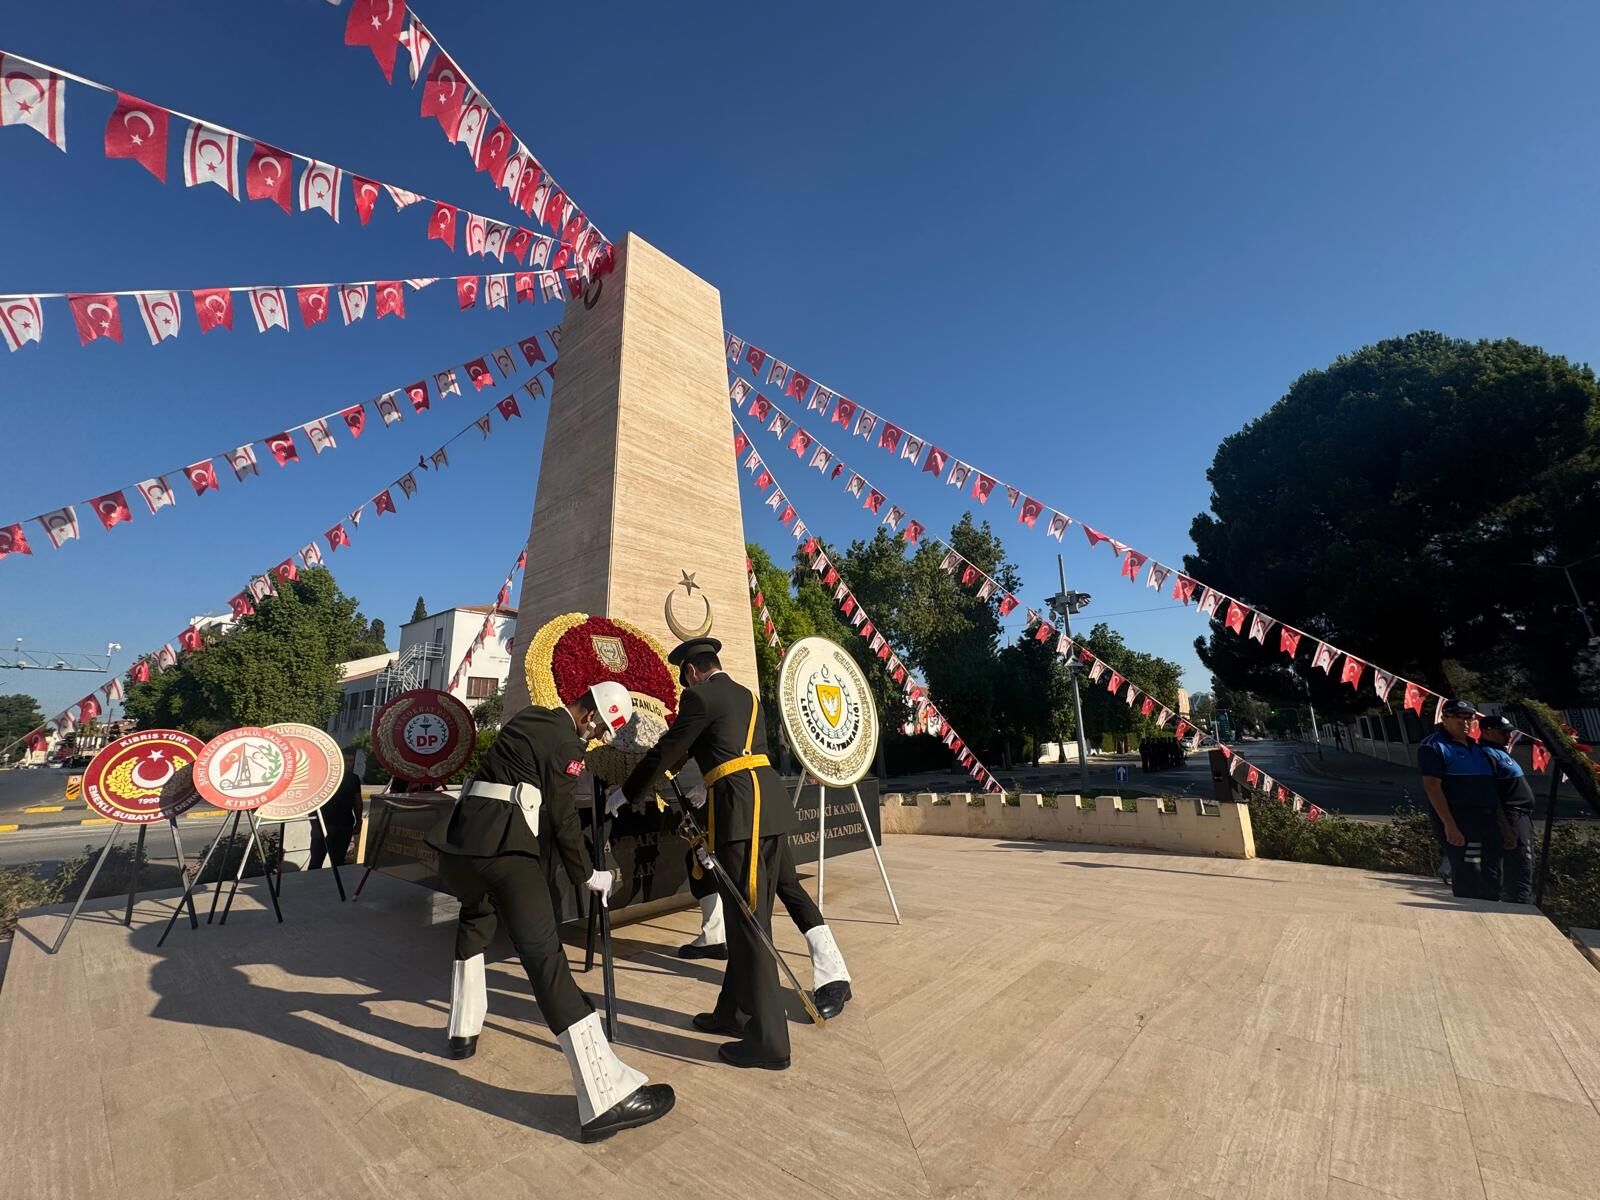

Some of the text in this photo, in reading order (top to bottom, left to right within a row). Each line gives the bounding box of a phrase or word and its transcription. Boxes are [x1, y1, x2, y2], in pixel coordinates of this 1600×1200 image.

[119, 733, 191, 747] KIBRIS TÜRK
[225, 733, 234, 741] VE
[416, 735, 438, 747] DP
[88, 785, 200, 821] EMEKLİ SUBAYLAR DERN
[224, 795, 268, 807] KIBRIS
[833, 802, 861, 816] KANDI
